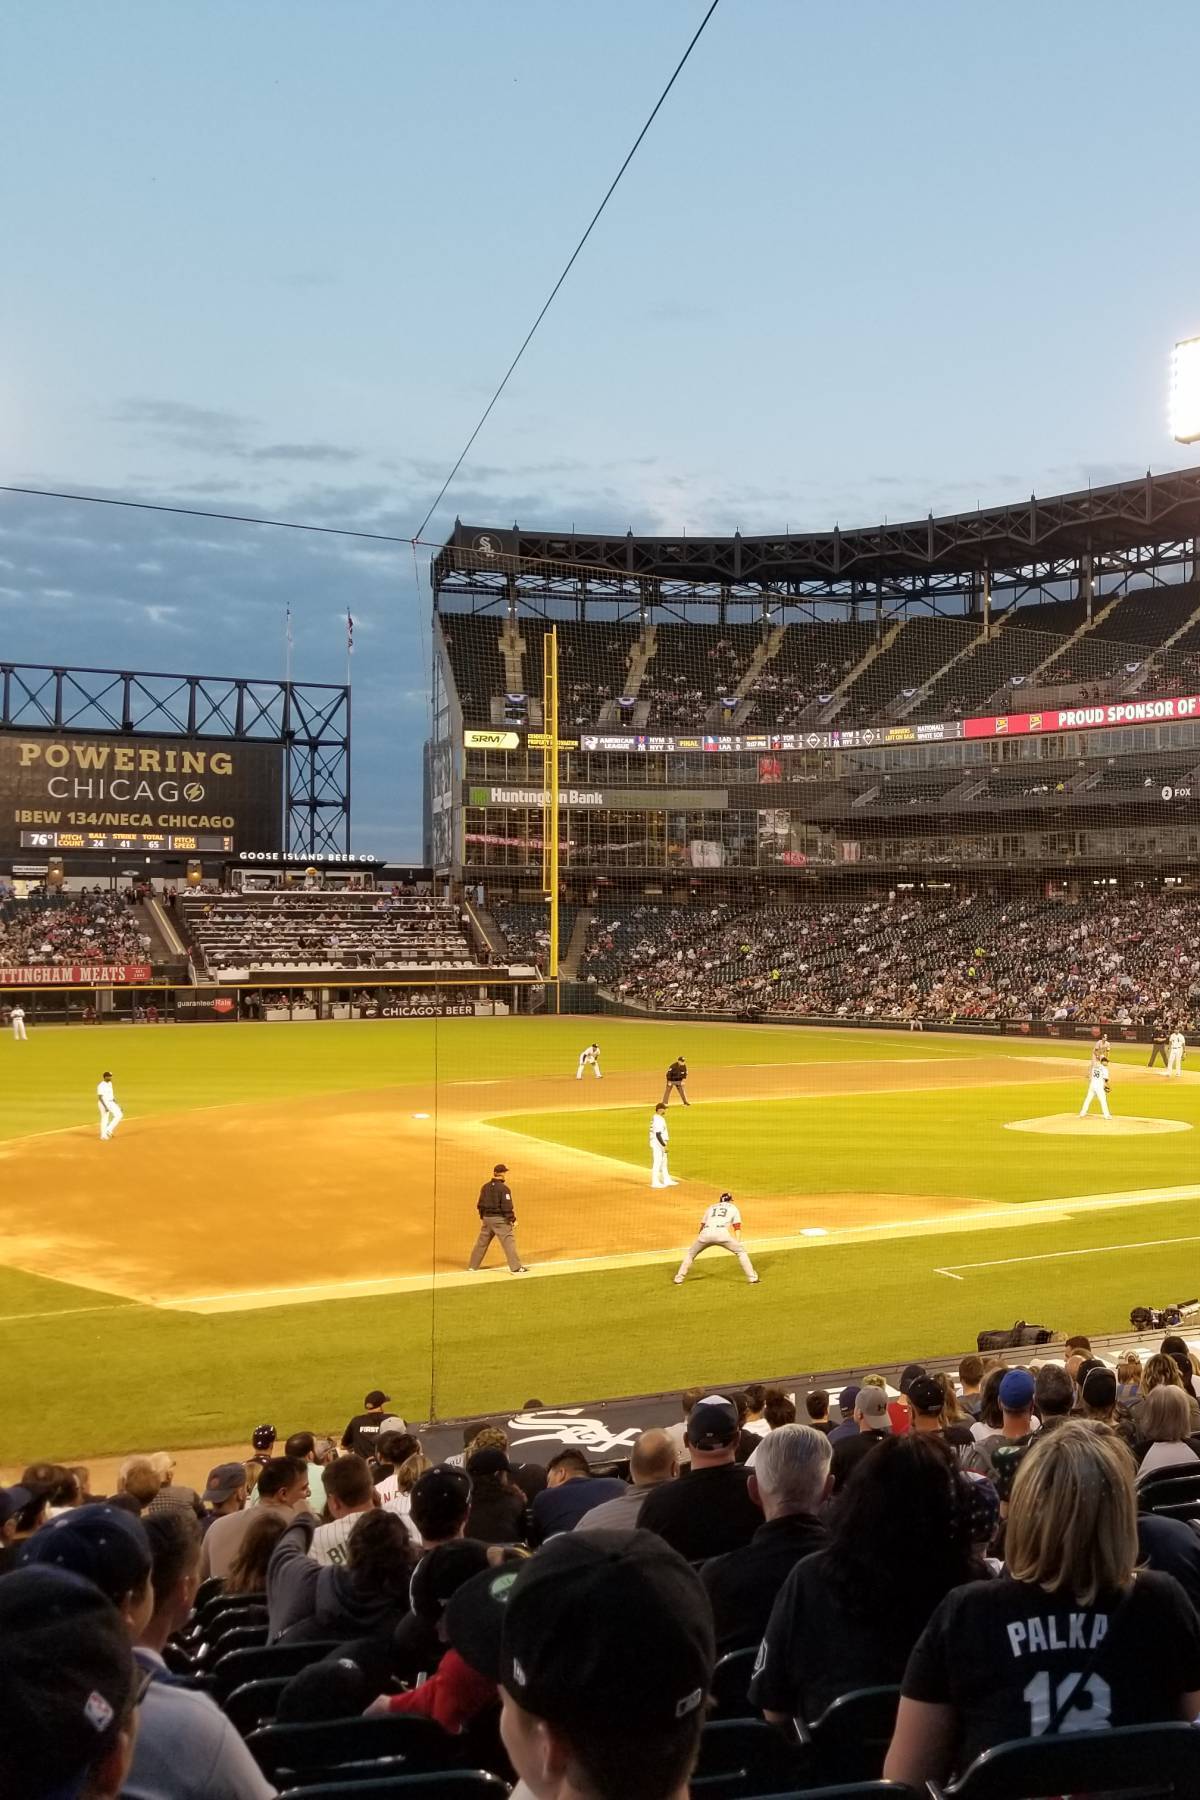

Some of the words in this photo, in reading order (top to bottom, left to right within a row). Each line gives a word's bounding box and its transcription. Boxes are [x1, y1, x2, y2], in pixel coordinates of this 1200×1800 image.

[1058, 709, 1104, 728] PROUD
[1107, 701, 1175, 722] SPONSOR
[1177, 696, 1199, 715] OF
[917, 724, 945, 732] NATIONALS
[471, 734, 500, 744] SRM
[19, 743, 233, 775] POWERING
[47, 776, 205, 802] CHICAGO
[1174, 787, 1191, 797] FOX
[491, 788, 568, 807] Huntingtn
[569, 790, 603, 805] Bank
[15, 810, 61, 825] IBEW
[67, 811, 153, 827] 134/NECA
[158, 815, 235, 829] CHICAGO
[239, 852, 279, 861] GOOSE
[283, 852, 325, 862] ISLAND
[328, 853, 356, 862] BEER
[359, 854, 379, 862] CO.
[81, 966, 126, 982] MEATS
[177, 999, 215, 1009] guaranteed
[215, 997, 232, 1007] Rate
[382, 1006, 442, 1017] CHICAGO'S
[446, 1006, 472, 1015] BEER
[711, 1207, 728, 1218] 13
